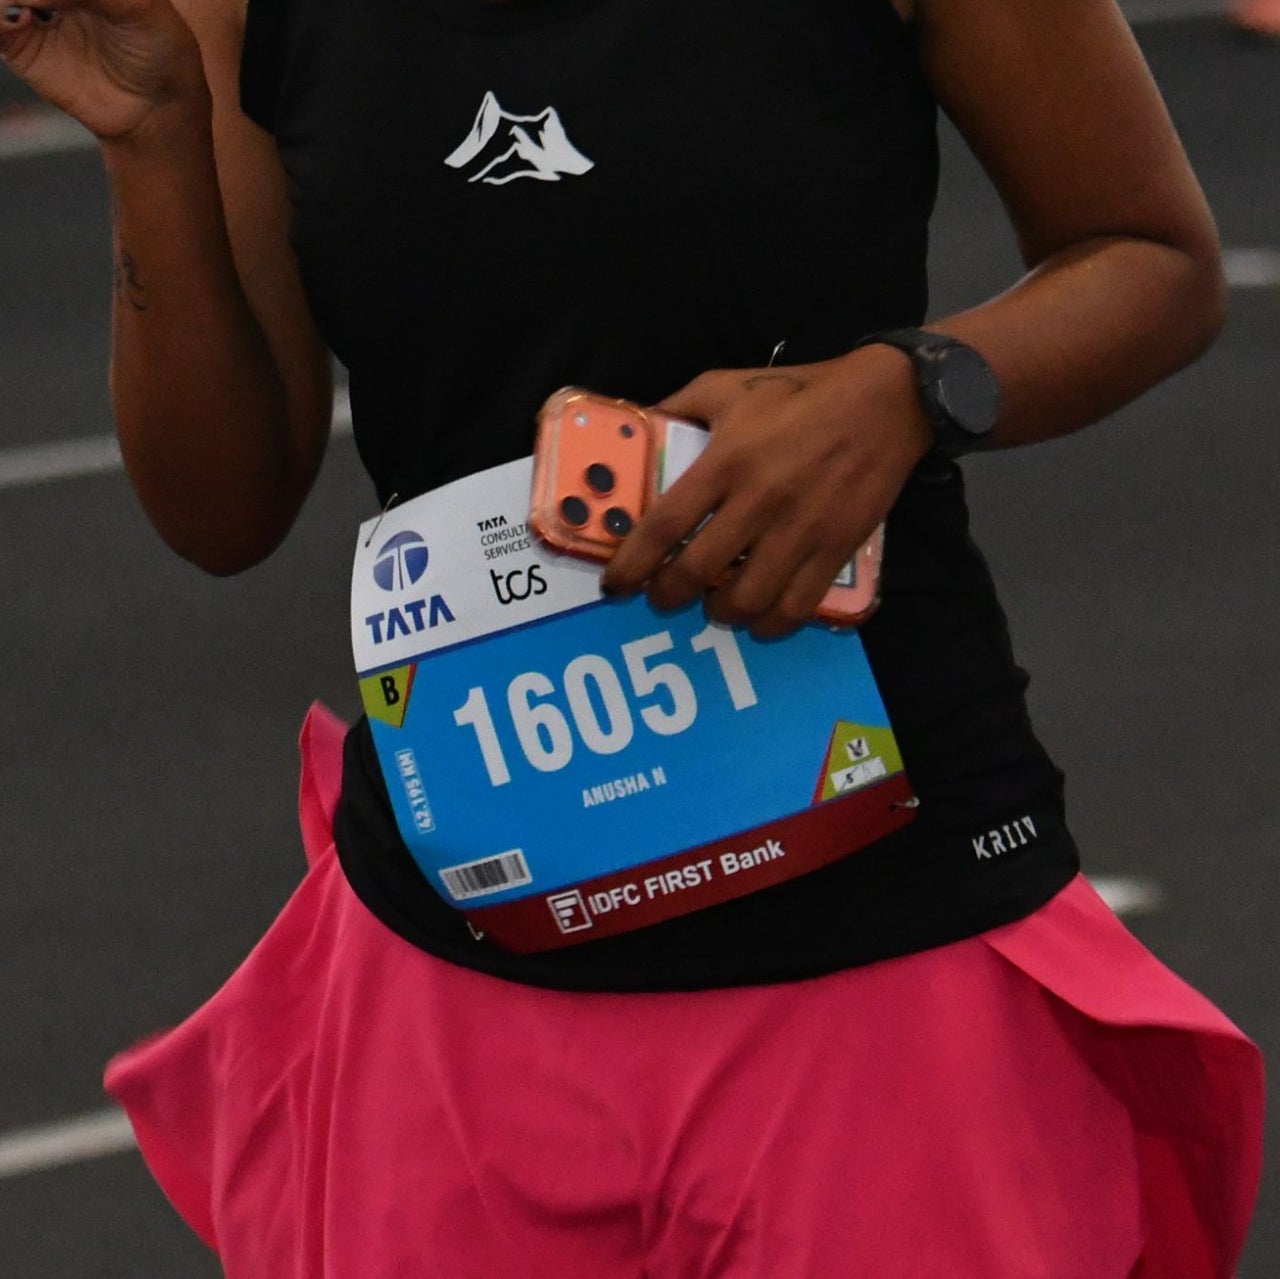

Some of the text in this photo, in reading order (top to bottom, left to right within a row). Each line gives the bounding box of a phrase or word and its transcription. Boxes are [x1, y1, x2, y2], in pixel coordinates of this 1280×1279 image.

[477, 515, 508, 532] TATA
[484, 538, 531, 560] SERVICES
[489, 564, 547, 605] tcs
[365, 594, 456, 644] TATA
[380, 675, 400, 706] B
[452, 624, 759, 788] 16051
[398, 752, 415, 777] KM
[582, 766, 667, 809] ANUSHA N
[588, 839, 787, 915] IDFC FIRST Bank
